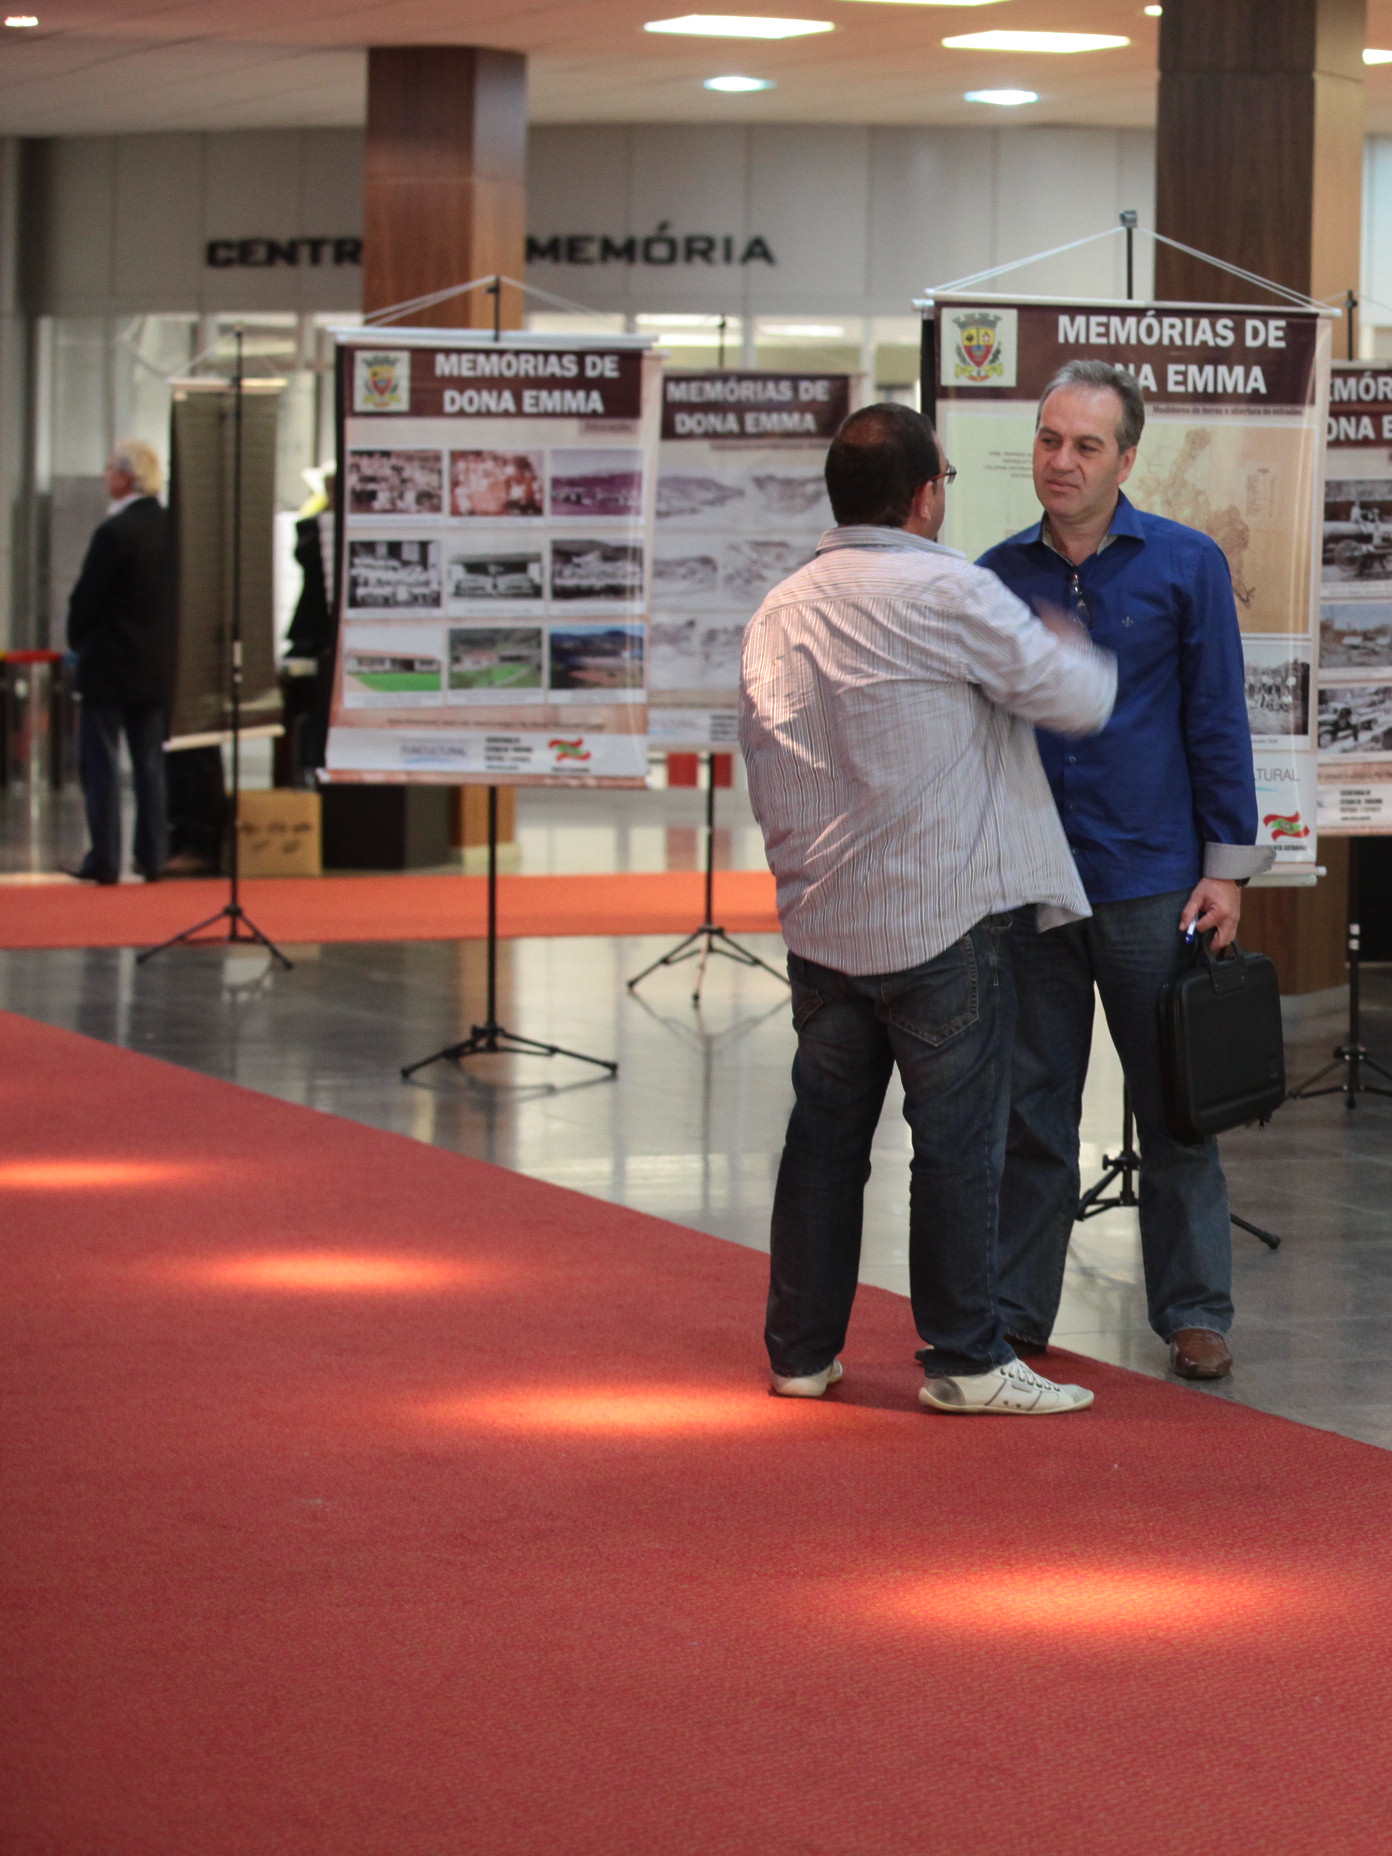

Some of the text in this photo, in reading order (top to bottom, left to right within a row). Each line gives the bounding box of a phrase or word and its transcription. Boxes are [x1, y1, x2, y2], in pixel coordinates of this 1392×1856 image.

[206, 219, 776, 268] CENTR MEMÓRIA
[1057, 310, 1287, 348] MEMÓRIAS DE
[434, 351, 621, 379] MEMÓRIAS DE
[665, 376, 831, 403] MEMÓRIAS DE
[1167, 364, 1267, 394] EMMA
[442, 389, 605, 414] DONA EMMA
[673, 411, 818, 434] DONA EMMA
[1327, 415, 1376, 441] ONA
